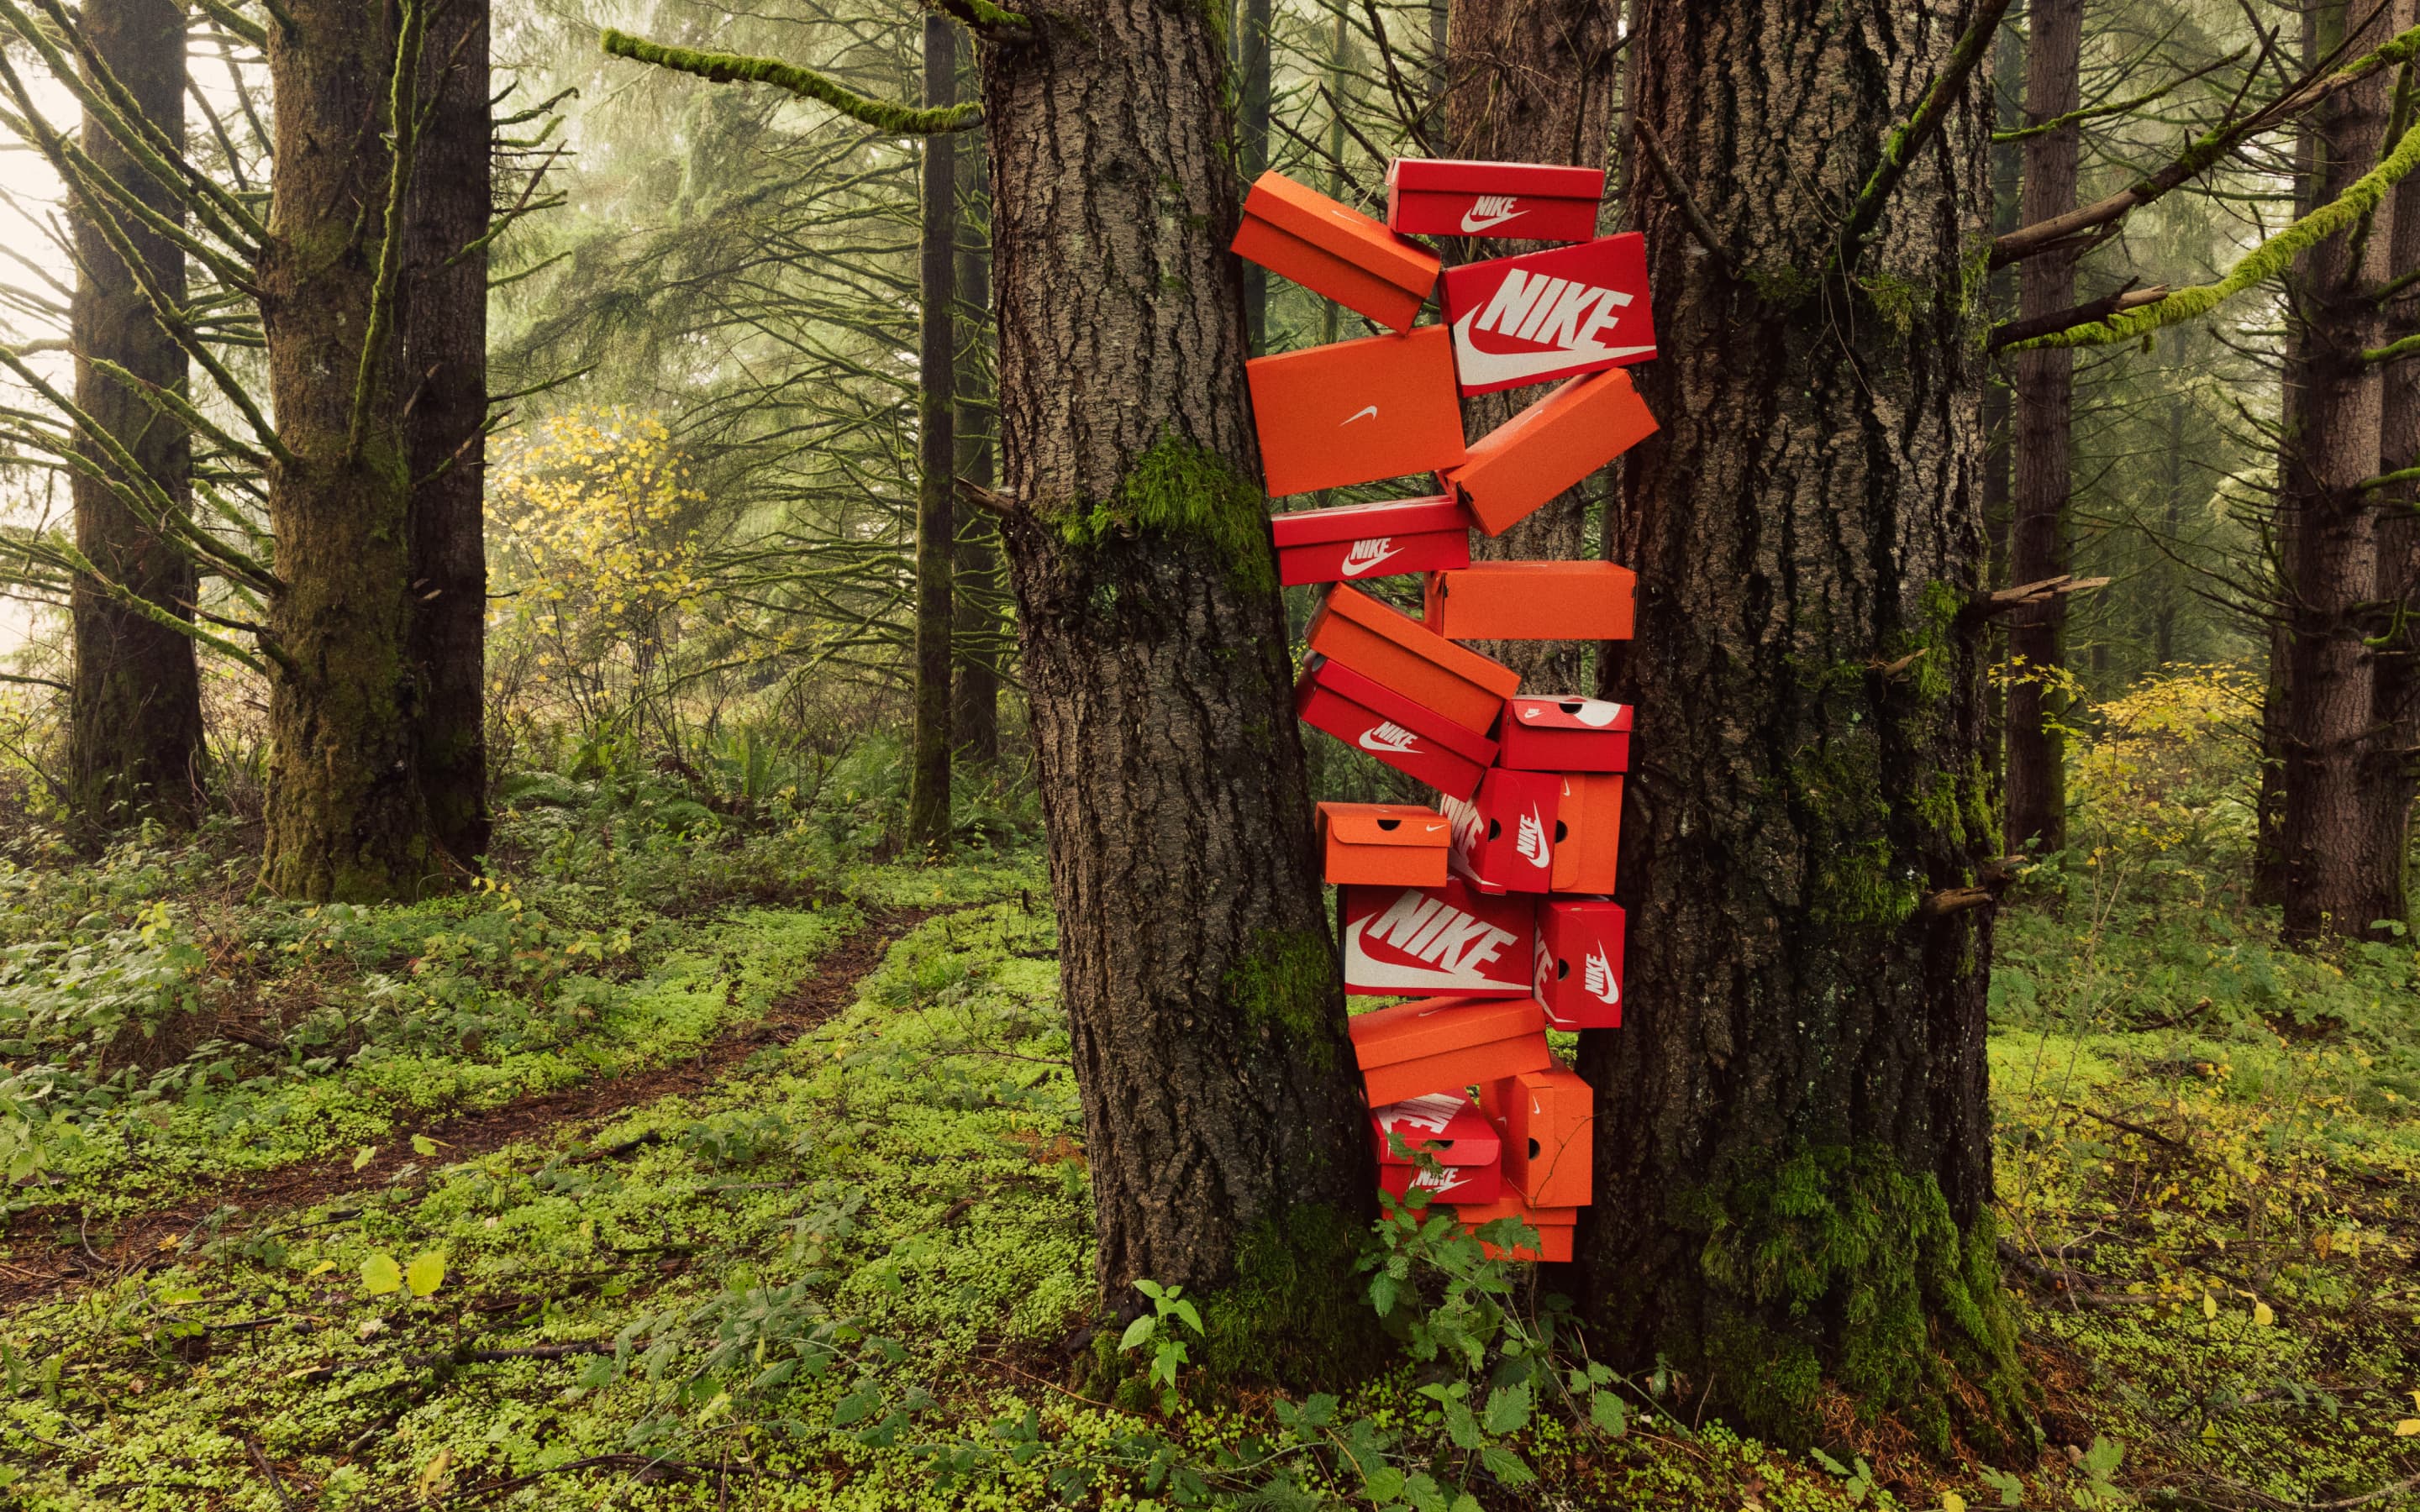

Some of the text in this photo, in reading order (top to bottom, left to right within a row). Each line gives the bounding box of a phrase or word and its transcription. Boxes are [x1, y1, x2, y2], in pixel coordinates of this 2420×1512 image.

[1471, 196, 1518, 217] NIKE
[1475, 268, 1634, 349] NIKE
[1350, 538, 1392, 560] NIKE
[1372, 721, 1418, 749] NIKE
[1517, 813, 1537, 858] NIKE
[1366, 888, 1518, 979] NIKE
[1585, 953, 1604, 996] NIKE
